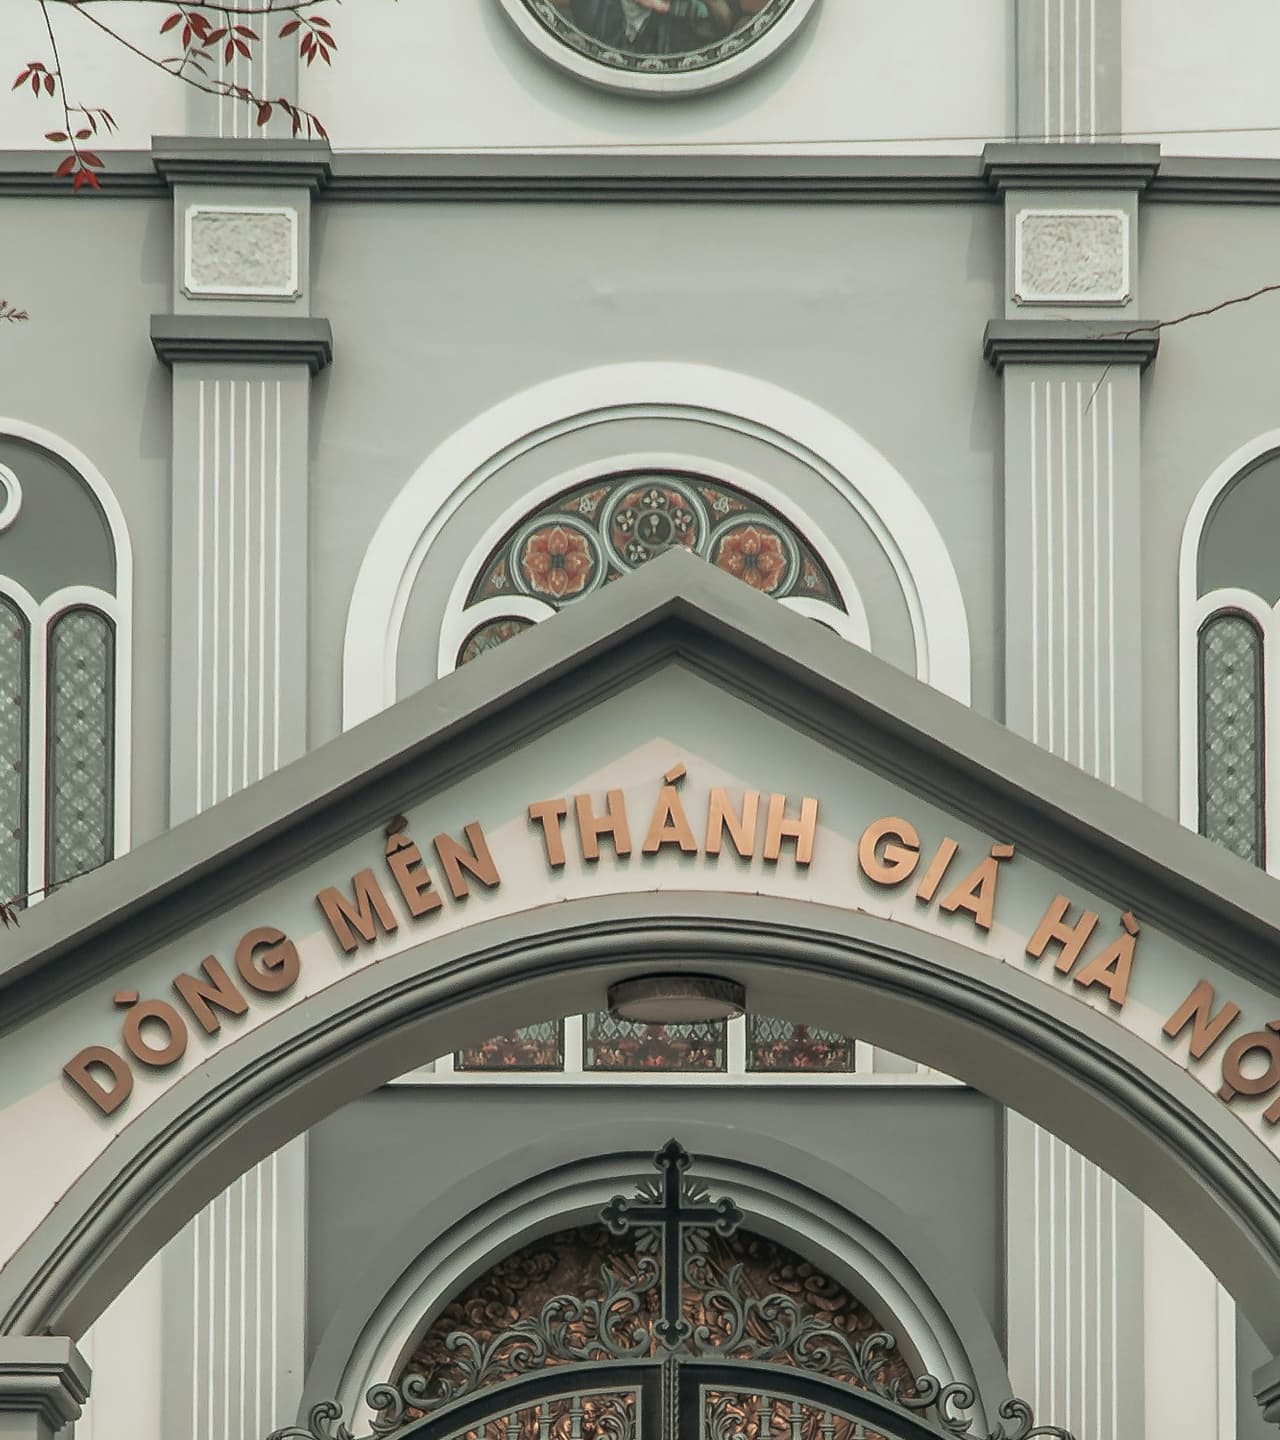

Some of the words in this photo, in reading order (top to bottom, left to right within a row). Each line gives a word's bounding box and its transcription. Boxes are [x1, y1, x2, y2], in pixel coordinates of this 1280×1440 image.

[63, 925, 301, 1115] DÒNG
[316, 814, 501, 953] MẾN
[528, 762, 818, 867] THÁNH
[858, 817, 1015, 931] GIÁ
[1025, 895, 1141, 1008] HÀ
